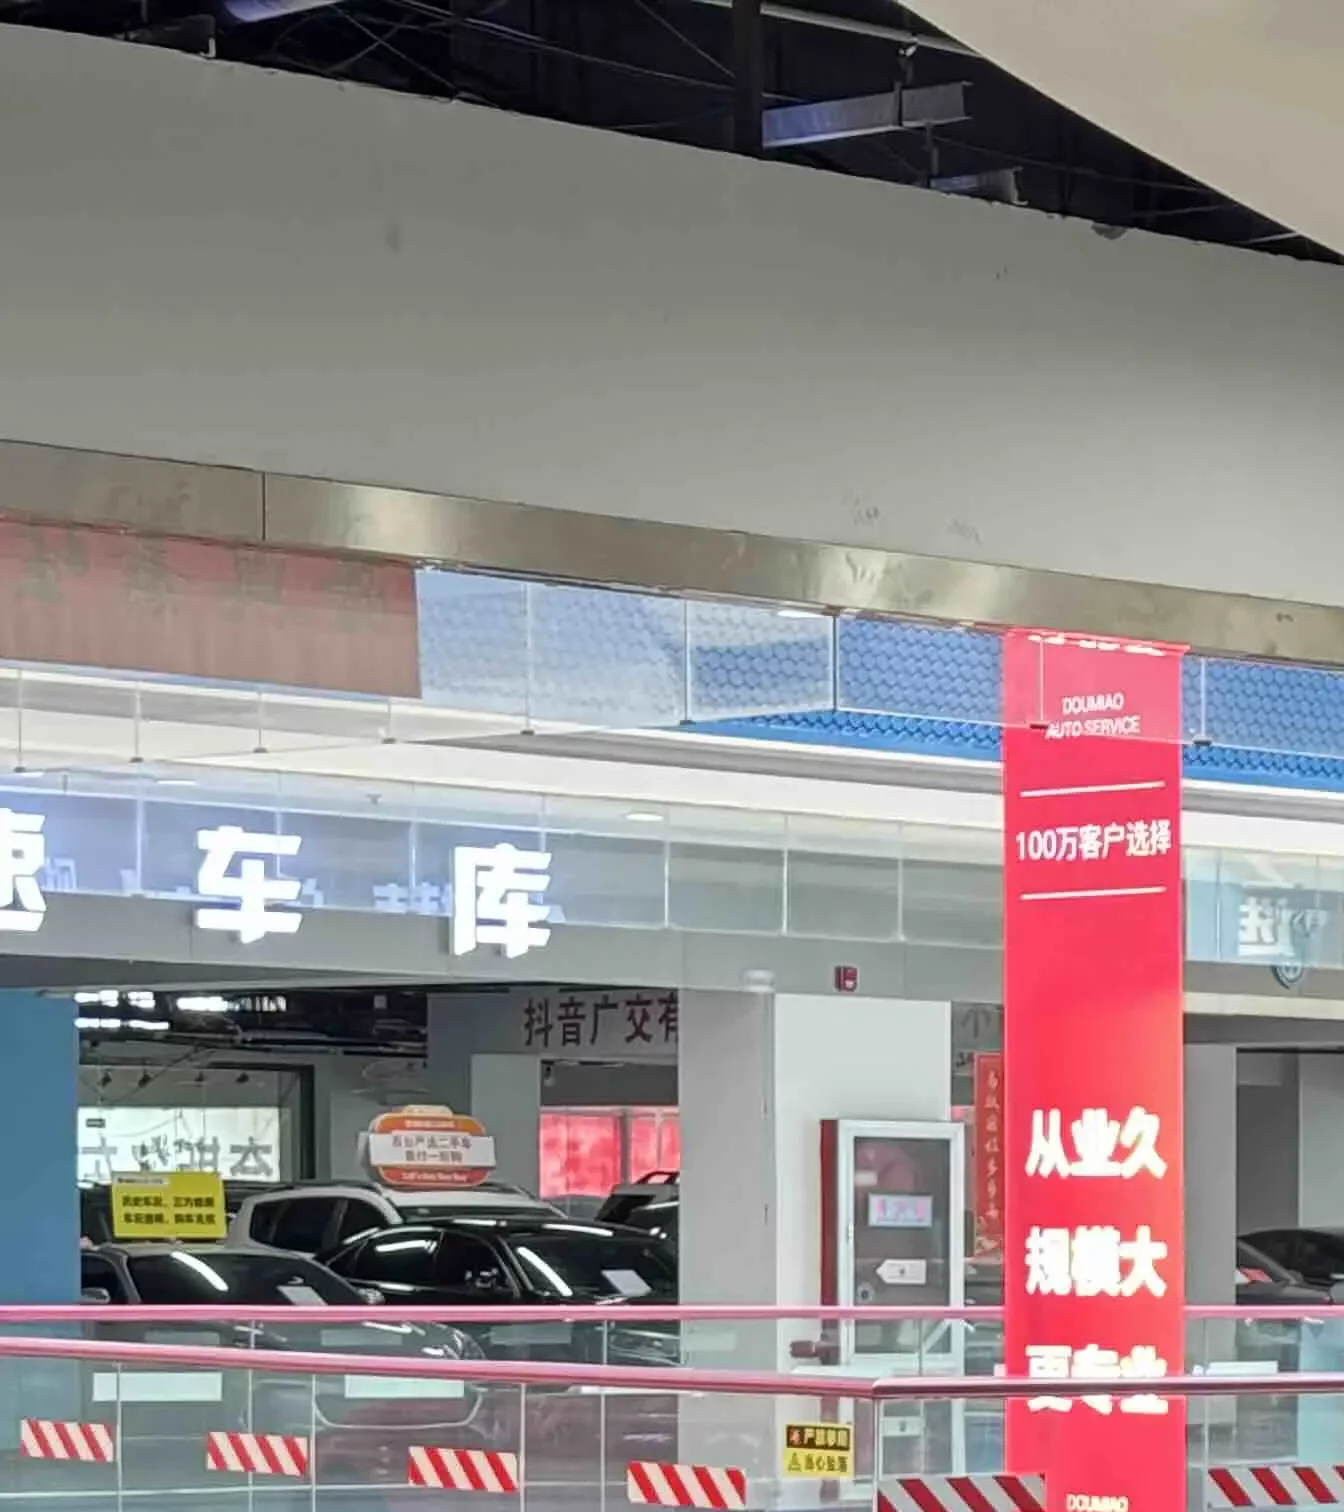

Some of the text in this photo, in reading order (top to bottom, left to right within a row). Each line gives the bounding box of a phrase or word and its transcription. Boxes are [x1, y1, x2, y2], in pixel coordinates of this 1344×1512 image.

[1046, 715, 1141, 739] AUTO SERVICE
[1062, 692, 1125, 715] DOUMIAO
[1016, 820, 1172, 862] 100万客户选择
[1025, 1105, 1167, 1179] 从业久
[1025, 1225, 1167, 1297] 规模大
[1025, 1343, 1168, 1415] 更专业
